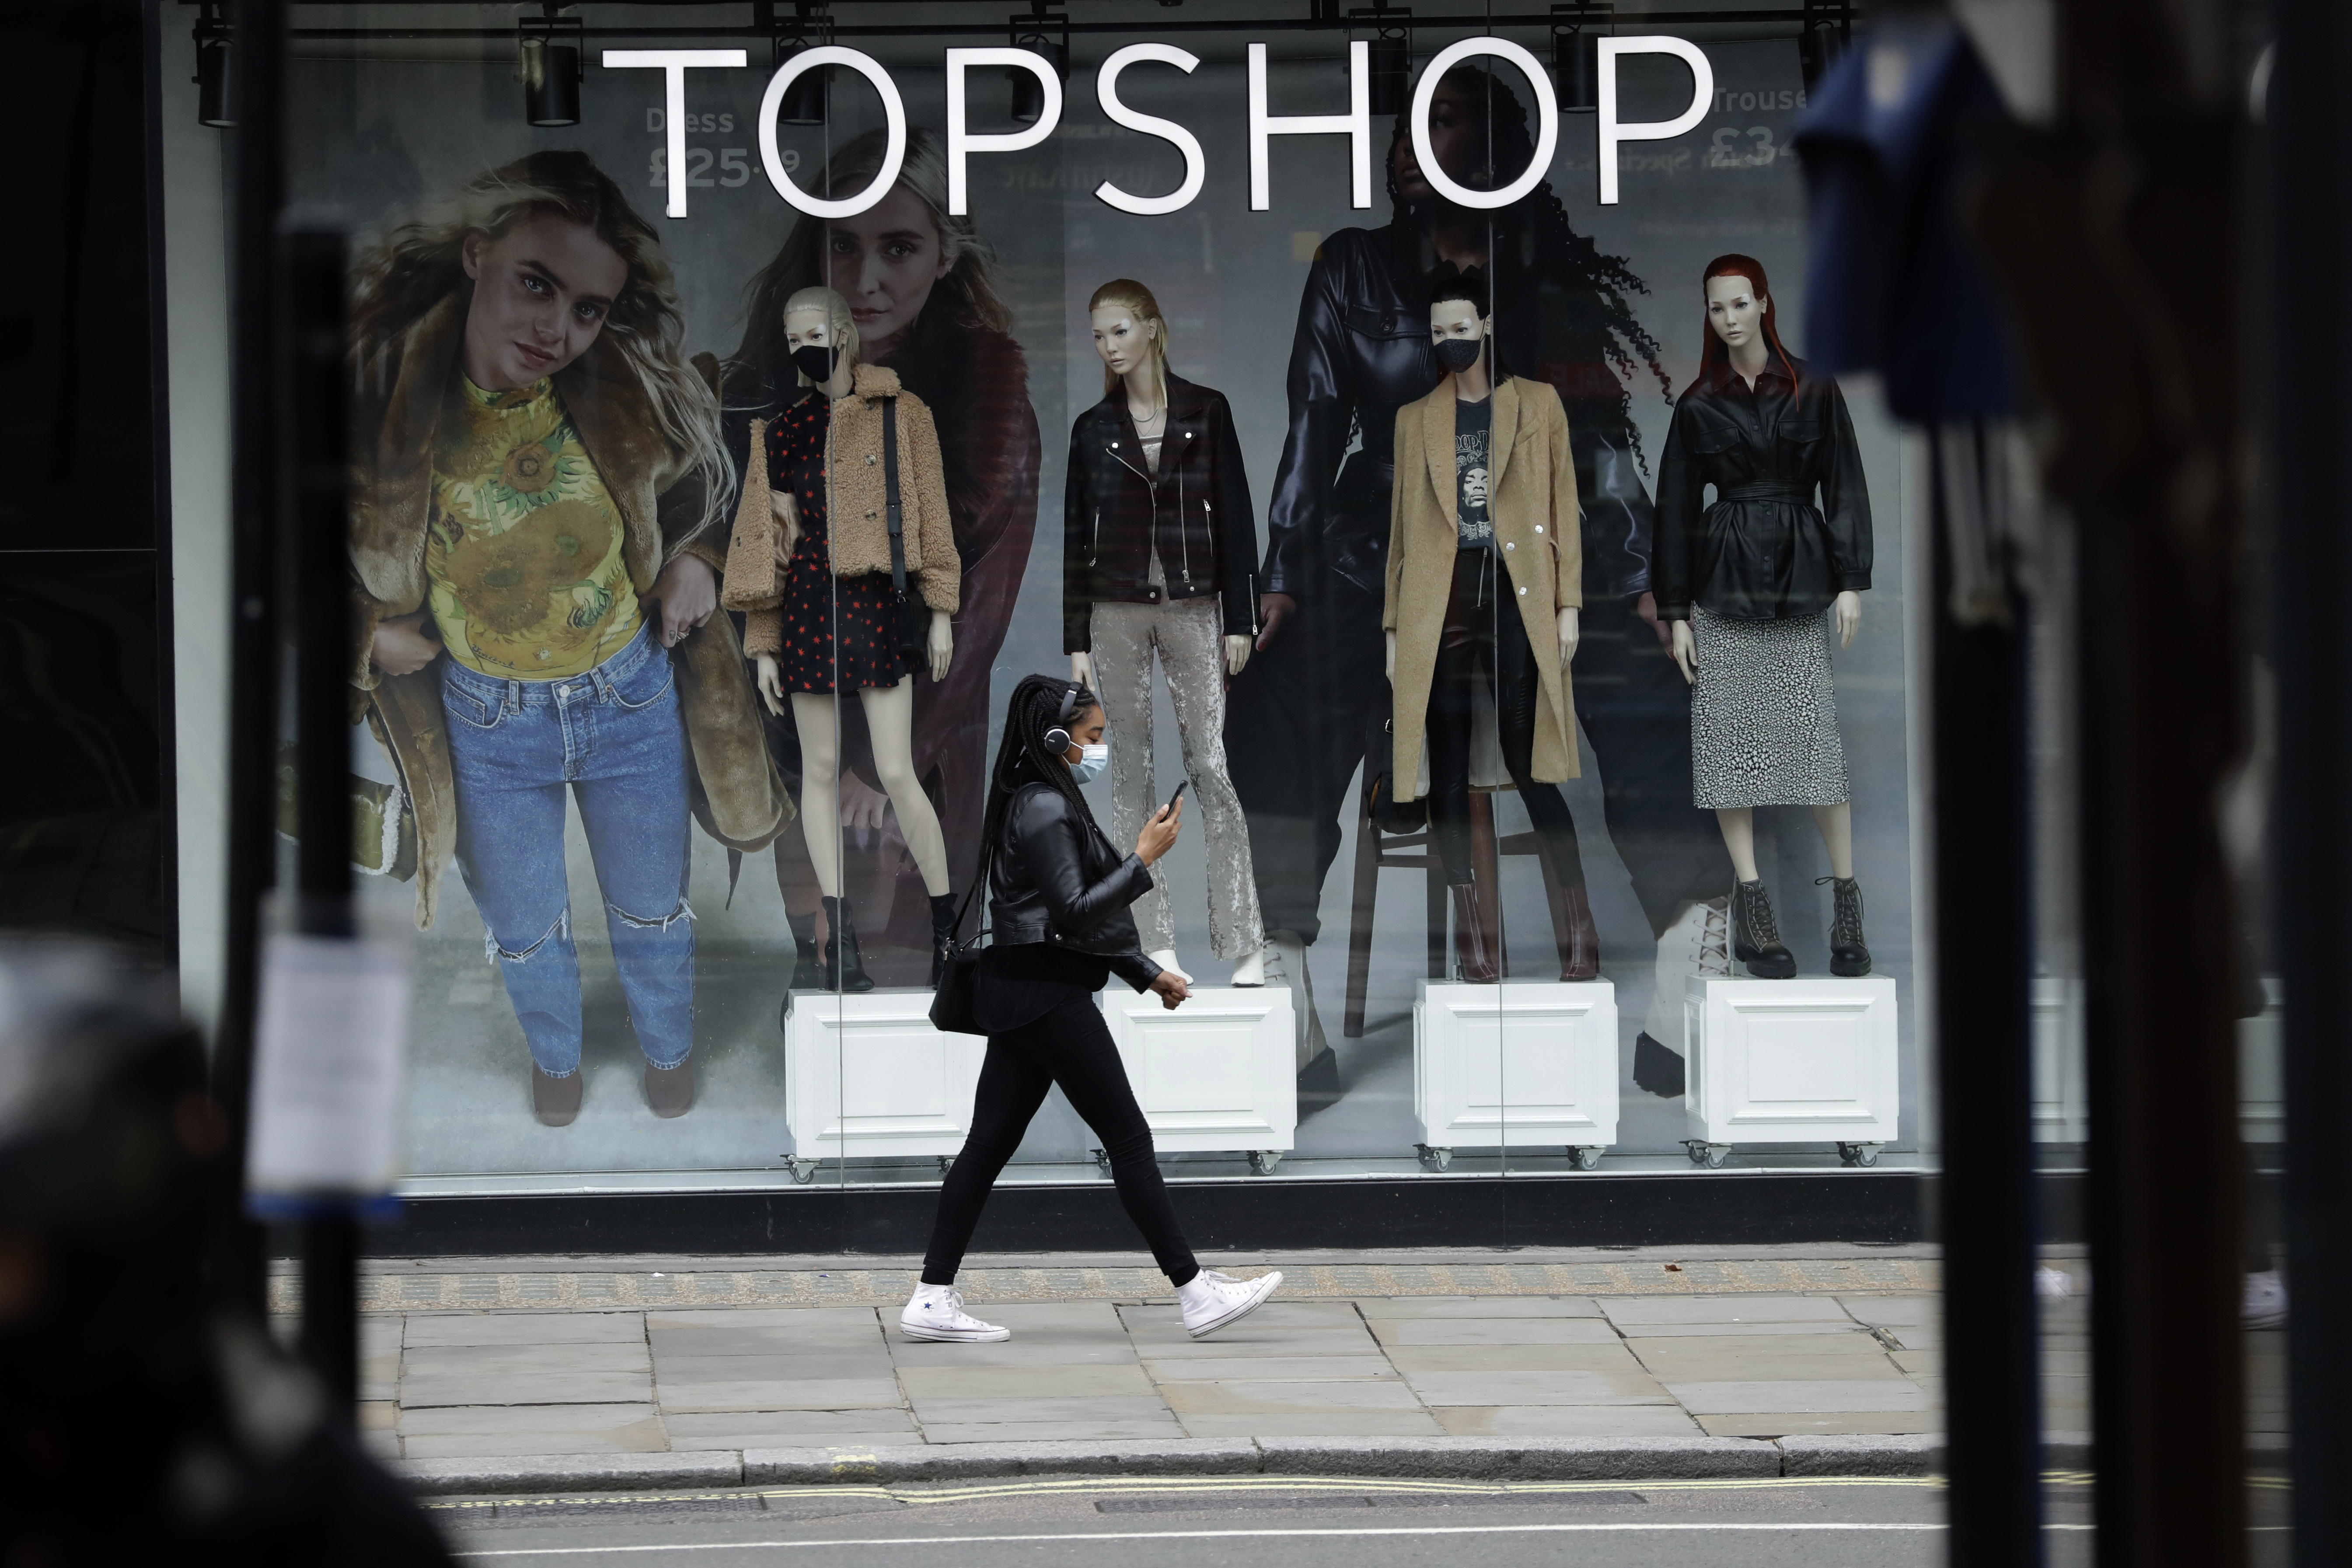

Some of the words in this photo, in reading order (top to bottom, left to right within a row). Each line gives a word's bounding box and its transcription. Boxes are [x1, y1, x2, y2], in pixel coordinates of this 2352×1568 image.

[1713, 87, 1807, 112] Trouse
[602, 35, 1713, 218] TOPSHOP
[647, 108, 733, 132] Dess
